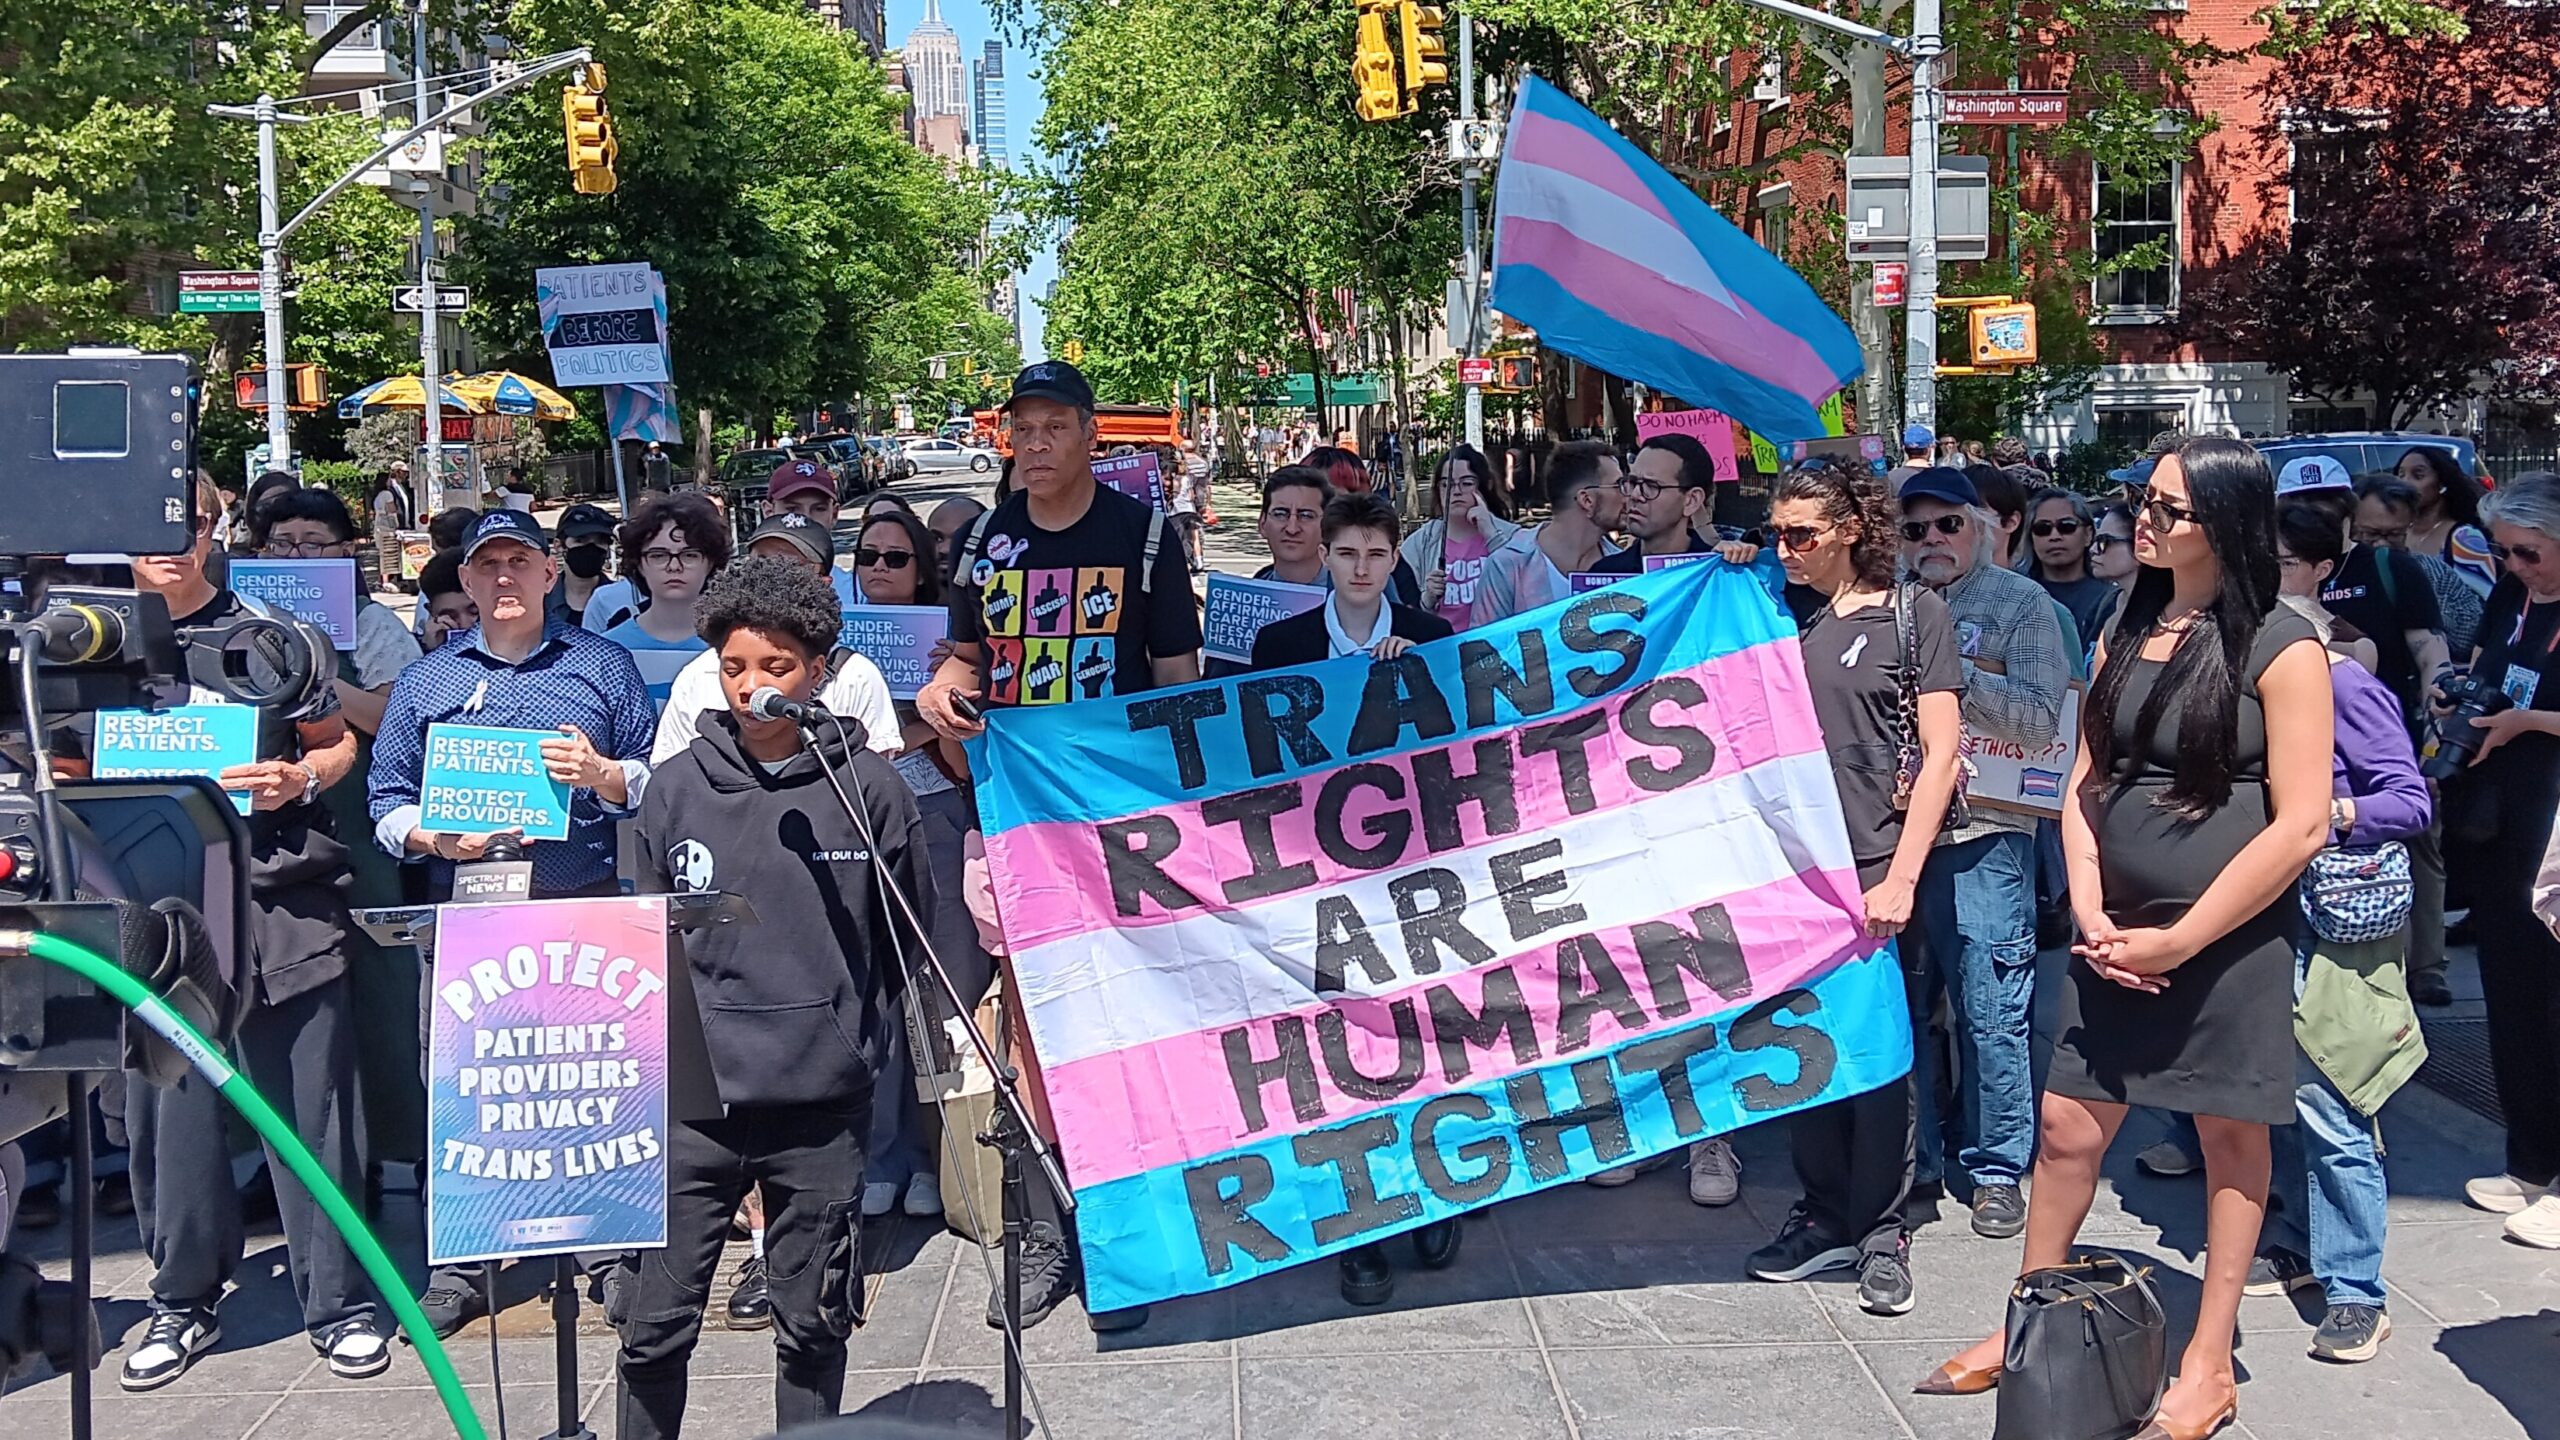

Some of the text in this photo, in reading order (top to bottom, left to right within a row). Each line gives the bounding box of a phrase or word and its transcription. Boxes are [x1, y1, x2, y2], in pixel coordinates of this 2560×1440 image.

[1945, 97, 2062, 117] Washington Square
[182, 275, 259, 288] Washington Square
[540, 269, 647, 300] PATIENTS
[409, 294, 423, 303] ON
[560, 312, 640, 345] BEFORE
[556, 349, 660, 377] POLITICS
[1637, 411, 1724, 428] DO NO HARM
[1091, 459, 1140, 474] YOUR OATH
[1147, 470, 1157, 483] DO
[1150, 485, 1160, 497] NO
[236, 575, 306, 587] GENDER-
[976, 564, 990, 580] T
[49, 597, 71, 606] AUDIO
[1211, 587, 1280, 607] GENDER-
[2323, 588, 2352, 601] KIDS
[984, 595, 1016, 617] TRUMP
[1030, 594, 1069, 618] FASCISM
[1081, 591, 1116, 619] ICE
[1210, 600, 1293, 620] AFFIRMING
[1210, 611, 1249, 627] CARE
[837, 633, 916, 646] AFFIRMING
[1208, 623, 1256, 641] LIFESA
[1208, 632, 1254, 650] HEALT
[878, 646, 891, 657] IS
[1027, 662, 1062, 688] WAR
[1075, 661, 1112, 681] GENOCIDE
[1126, 591, 1650, 790] TRANS
[104, 715, 207, 734] RESPECT
[103, 733, 222, 751] PATIENTS.
[434, 736, 528, 758] RESPECT
[1971, 736, 2024, 760] ETHICS
[431, 753, 541, 776] PATIENTS.
[429, 786, 528, 807] PROTECT
[1098, 677, 1716, 918] RIGHTS
[426, 803, 553, 826] PROVIDERS.
[458, 874, 505, 885] SPECTRUM
[466, 882, 504, 894] NEWS
[1313, 837, 1588, 994] ARE
[439, 941, 664, 1023] PROTECT
[1221, 901, 1754, 1135] HUMAN
[474, 1023, 626, 1059] PATIENTS
[459, 1059, 640, 1097] PROVIDERS
[481, 1096, 619, 1133] PRIVACY
[1182, 988, 1838, 1276] RIGHTS
[442, 1127, 660, 1181] TRANS LIVES
